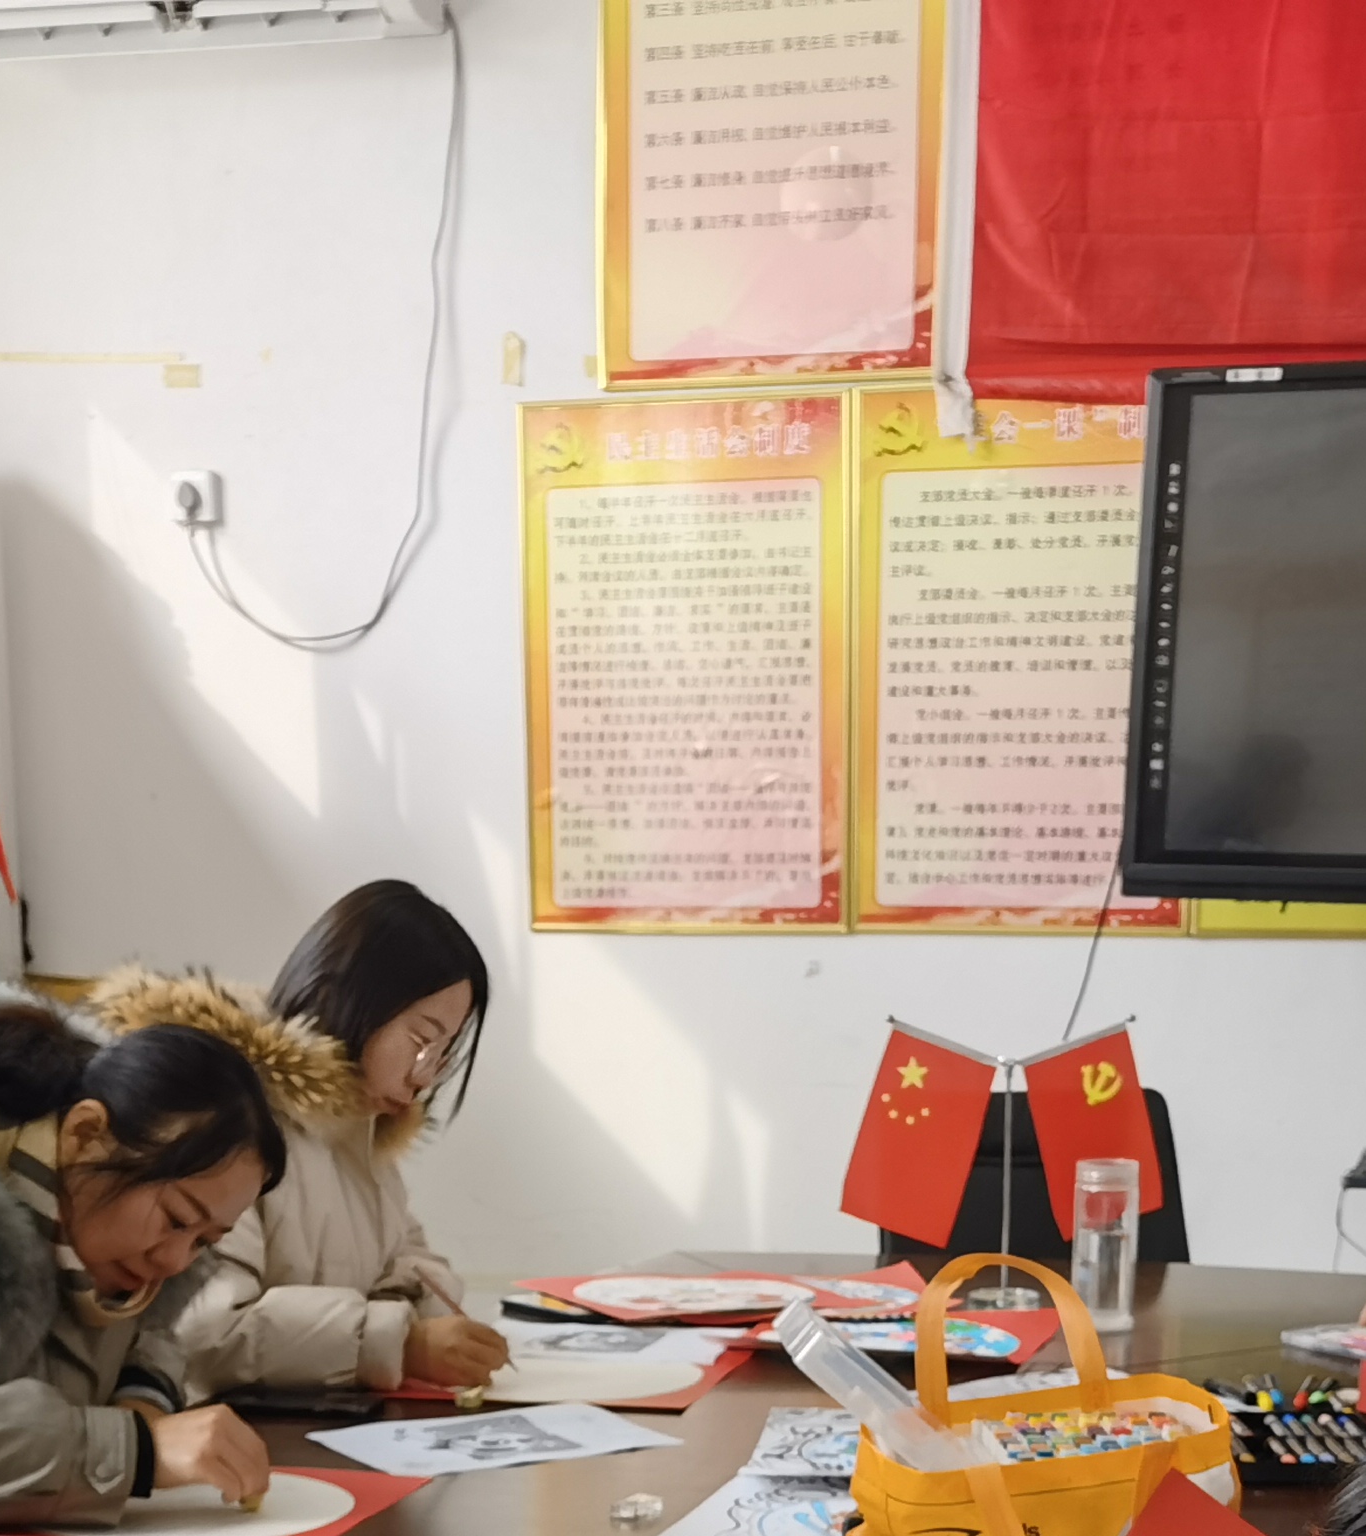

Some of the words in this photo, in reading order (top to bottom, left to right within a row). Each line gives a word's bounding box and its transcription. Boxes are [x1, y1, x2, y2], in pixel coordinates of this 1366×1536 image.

[604, 421, 813, 462] 民主生活会制度
